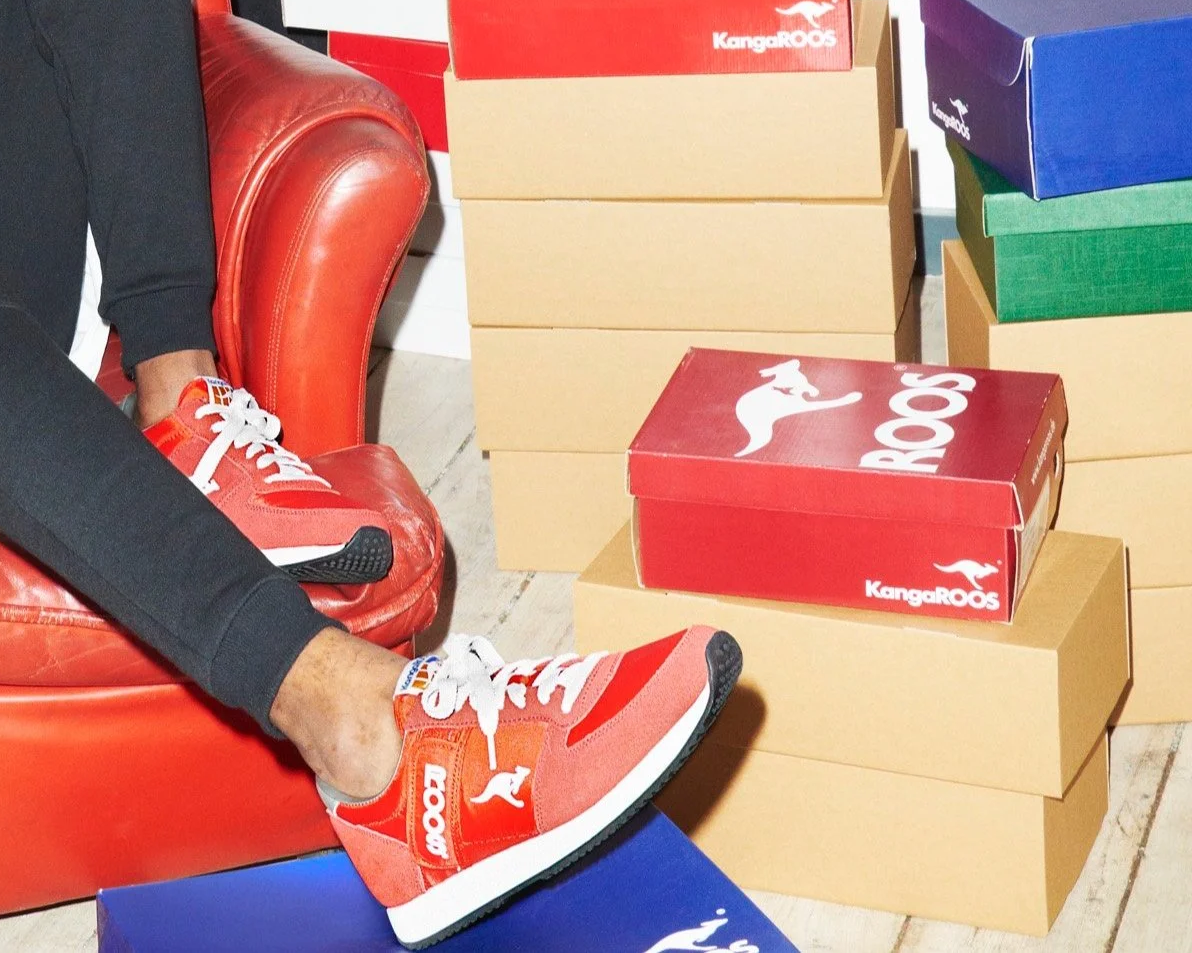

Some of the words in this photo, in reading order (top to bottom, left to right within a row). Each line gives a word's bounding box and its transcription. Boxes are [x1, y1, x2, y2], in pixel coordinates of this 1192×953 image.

[712, 29, 837, 54] KangaROOS
[932, 101, 970, 141] KangaROOS
[865, 579, 1000, 611] KangaROOS
[422, 763, 450, 860] ROOS
